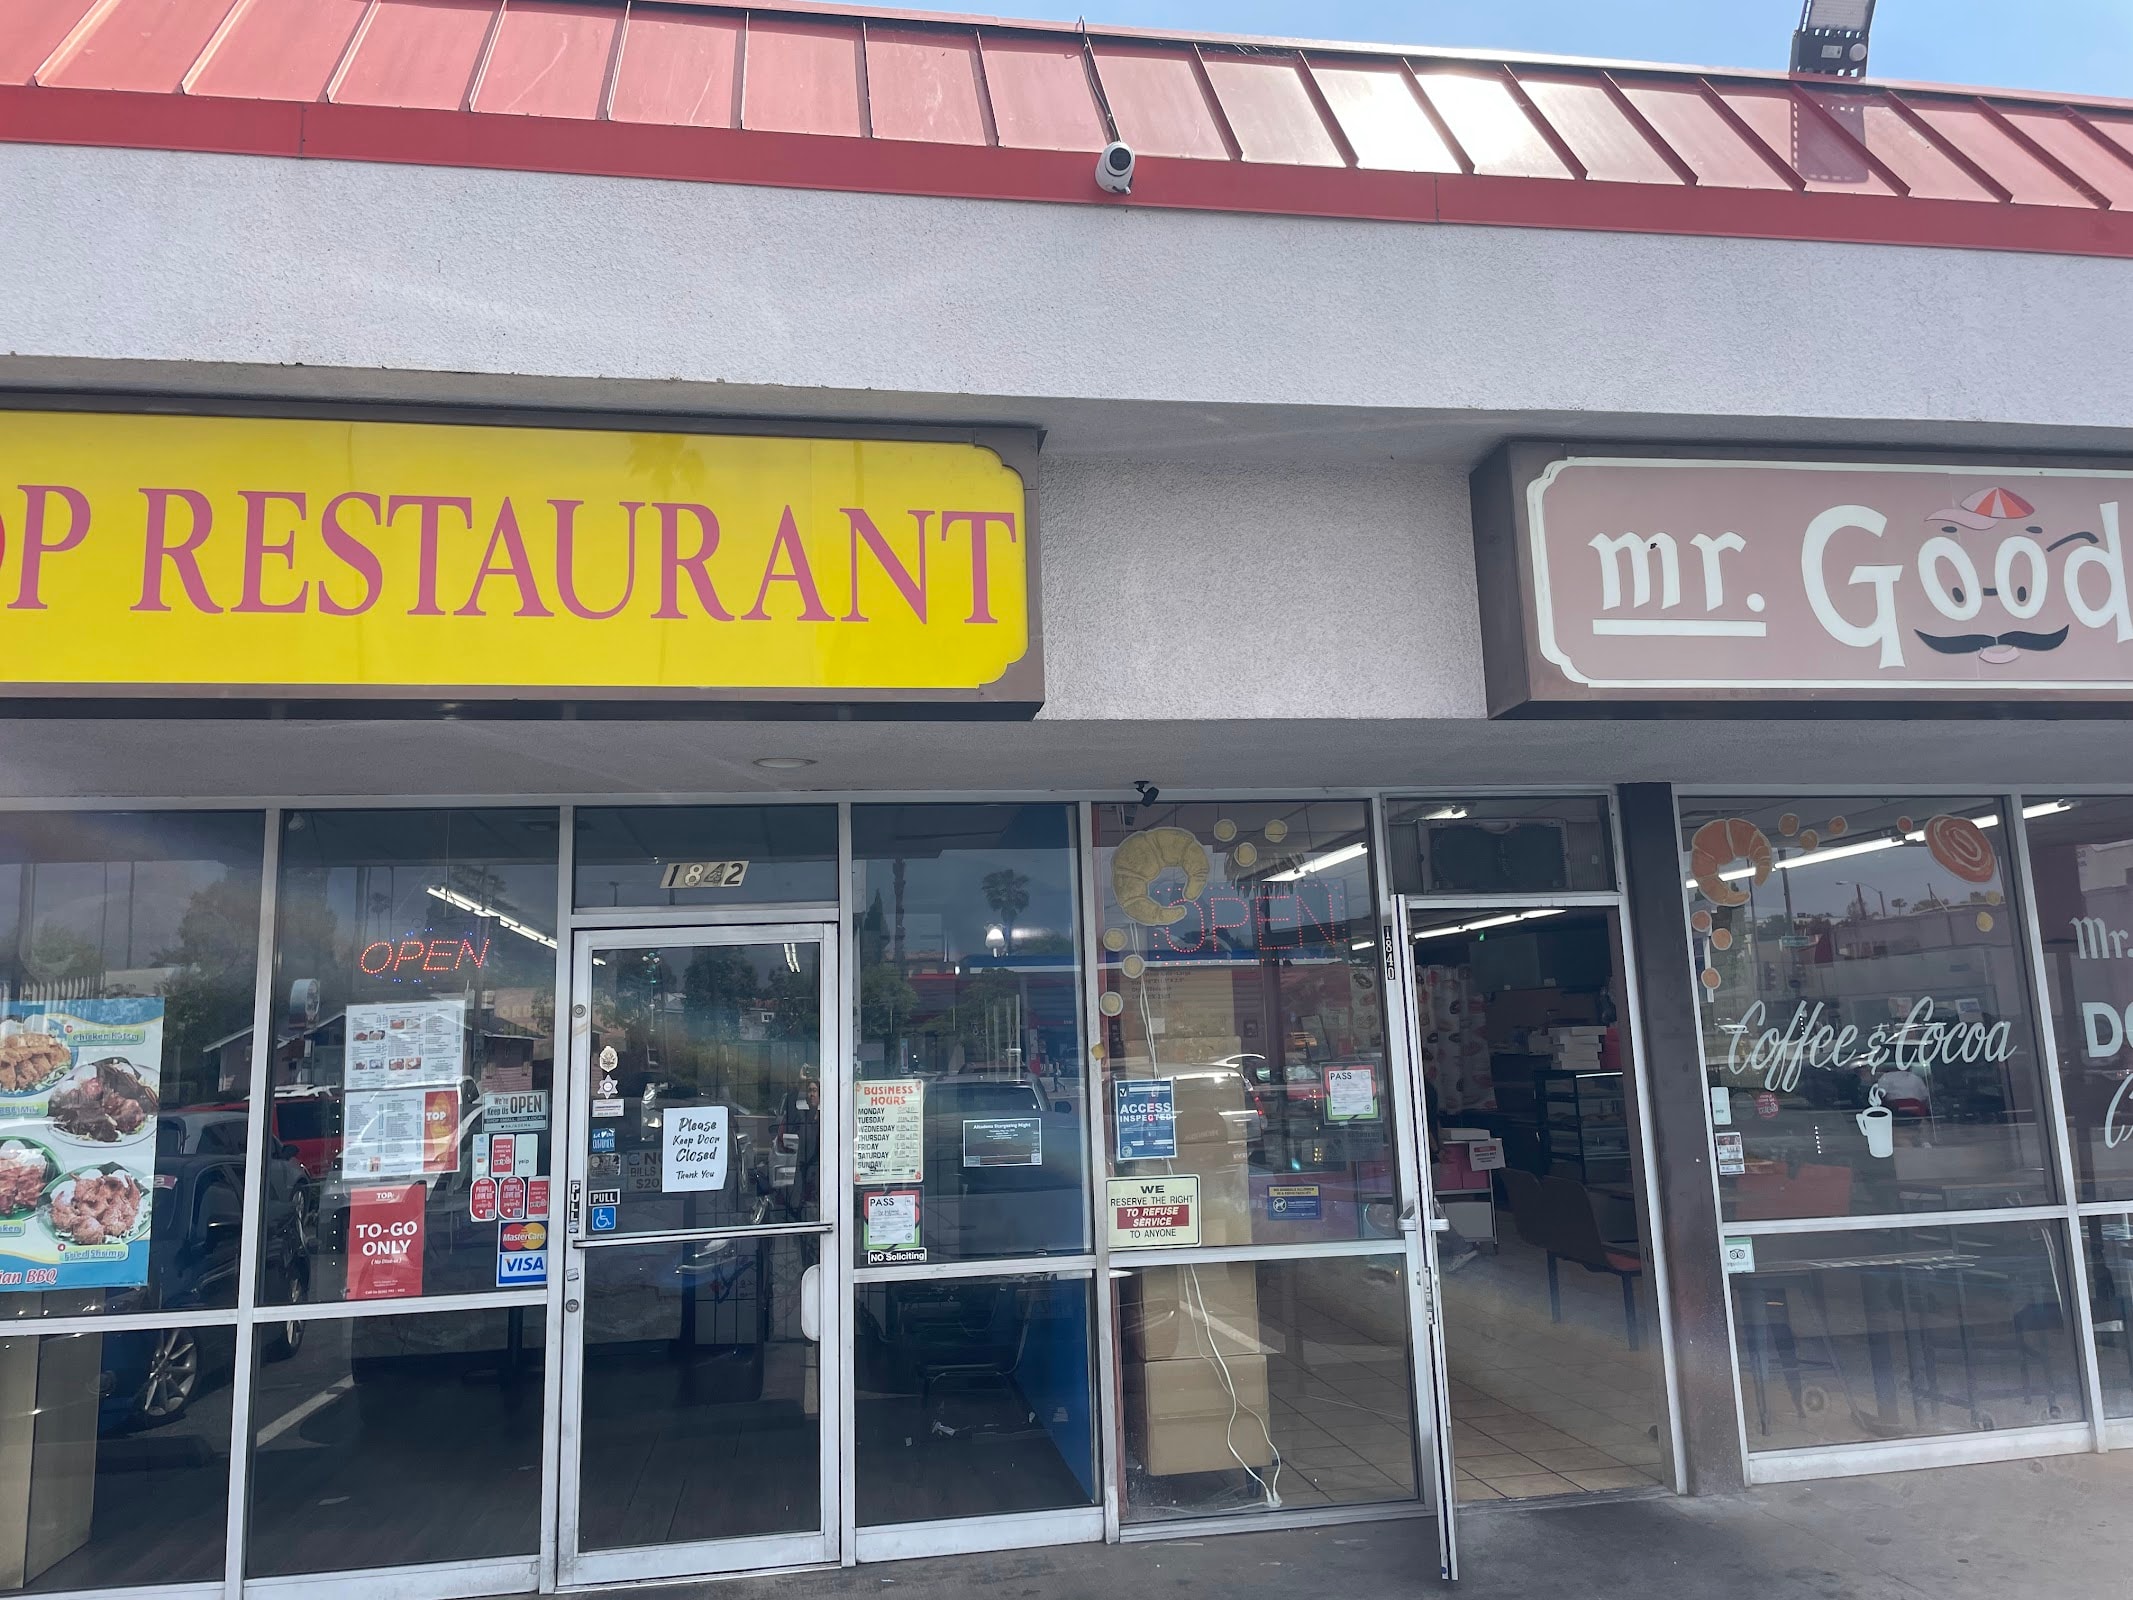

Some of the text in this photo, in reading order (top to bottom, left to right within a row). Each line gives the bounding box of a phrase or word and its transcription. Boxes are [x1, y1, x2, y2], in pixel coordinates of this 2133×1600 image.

[0, 485, 1016, 626] P RESTAURANT
[1588, 530, 1766, 612] mr.
[667, 862, 744, 887] 1842
[1166, 894, 1337, 953] OPEN
[360, 938, 491, 974] OPEN
[1385, 926, 1395, 980] 1840
[2082, 1002, 2133, 1058] D
[1728, 996, 2017, 1093] Coffee & Cocoa
[1330, 1072, 1352, 1080] PASS
[510, 1095, 542, 1114] OPEN
[871, 1096, 907, 1106] HOURS
[857, 1107, 885, 1115] MONDAY
[1120, 1102, 1171, 1114] ACCESS
[426, 1111, 447, 1121] TOP
[857, 1116, 885, 1124] TUESDAY
[1120, 1113, 1172, 1122] INSPECTED
[678, 1117, 717, 1132] Please
[858, 1125, 895, 1133] WEDNESDAY
[672, 1134, 720, 1148] Keep Door
[858, 1134, 890, 1142] THURSDAY
[857, 1143, 879, 1151] FRIDAY
[644, 1153, 663, 1165] N
[675, 1147, 718, 1162] Closed
[857, 1152, 889, 1160] SATURDAY
[857, 1161, 882, 1169] SUNDAY
[630, 1166, 656, 1177] BILLS
[675, 1169, 715, 1180] Thank You
[1140, 1185, 1165, 1194] WE
[376, 1191, 393, 1200] TOP
[593, 1193, 616, 1203] PULL
[1111, 1195, 1194, 1206] RESERVE THE RIGHT
[570, 1183, 580, 1221] PULL
[870, 1197, 895, 1207] PASS
[1127, 1206, 1179, 1217] TO REFUSE
[0, 1222, 22, 1233] ken
[1133, 1217, 1172, 1227] SERVICE
[356, 1220, 418, 1239] TO-GO
[1130, 1228, 1177, 1239] TO ANYONE
[503, 1232, 546, 1242] MasterCard
[362, 1239, 411, 1257] ONLY
[870, 1251, 924, 1263] NO Soliciting
[505, 1256, 545, 1272] VISA
[26, 1269, 57, 1284] BBQ
